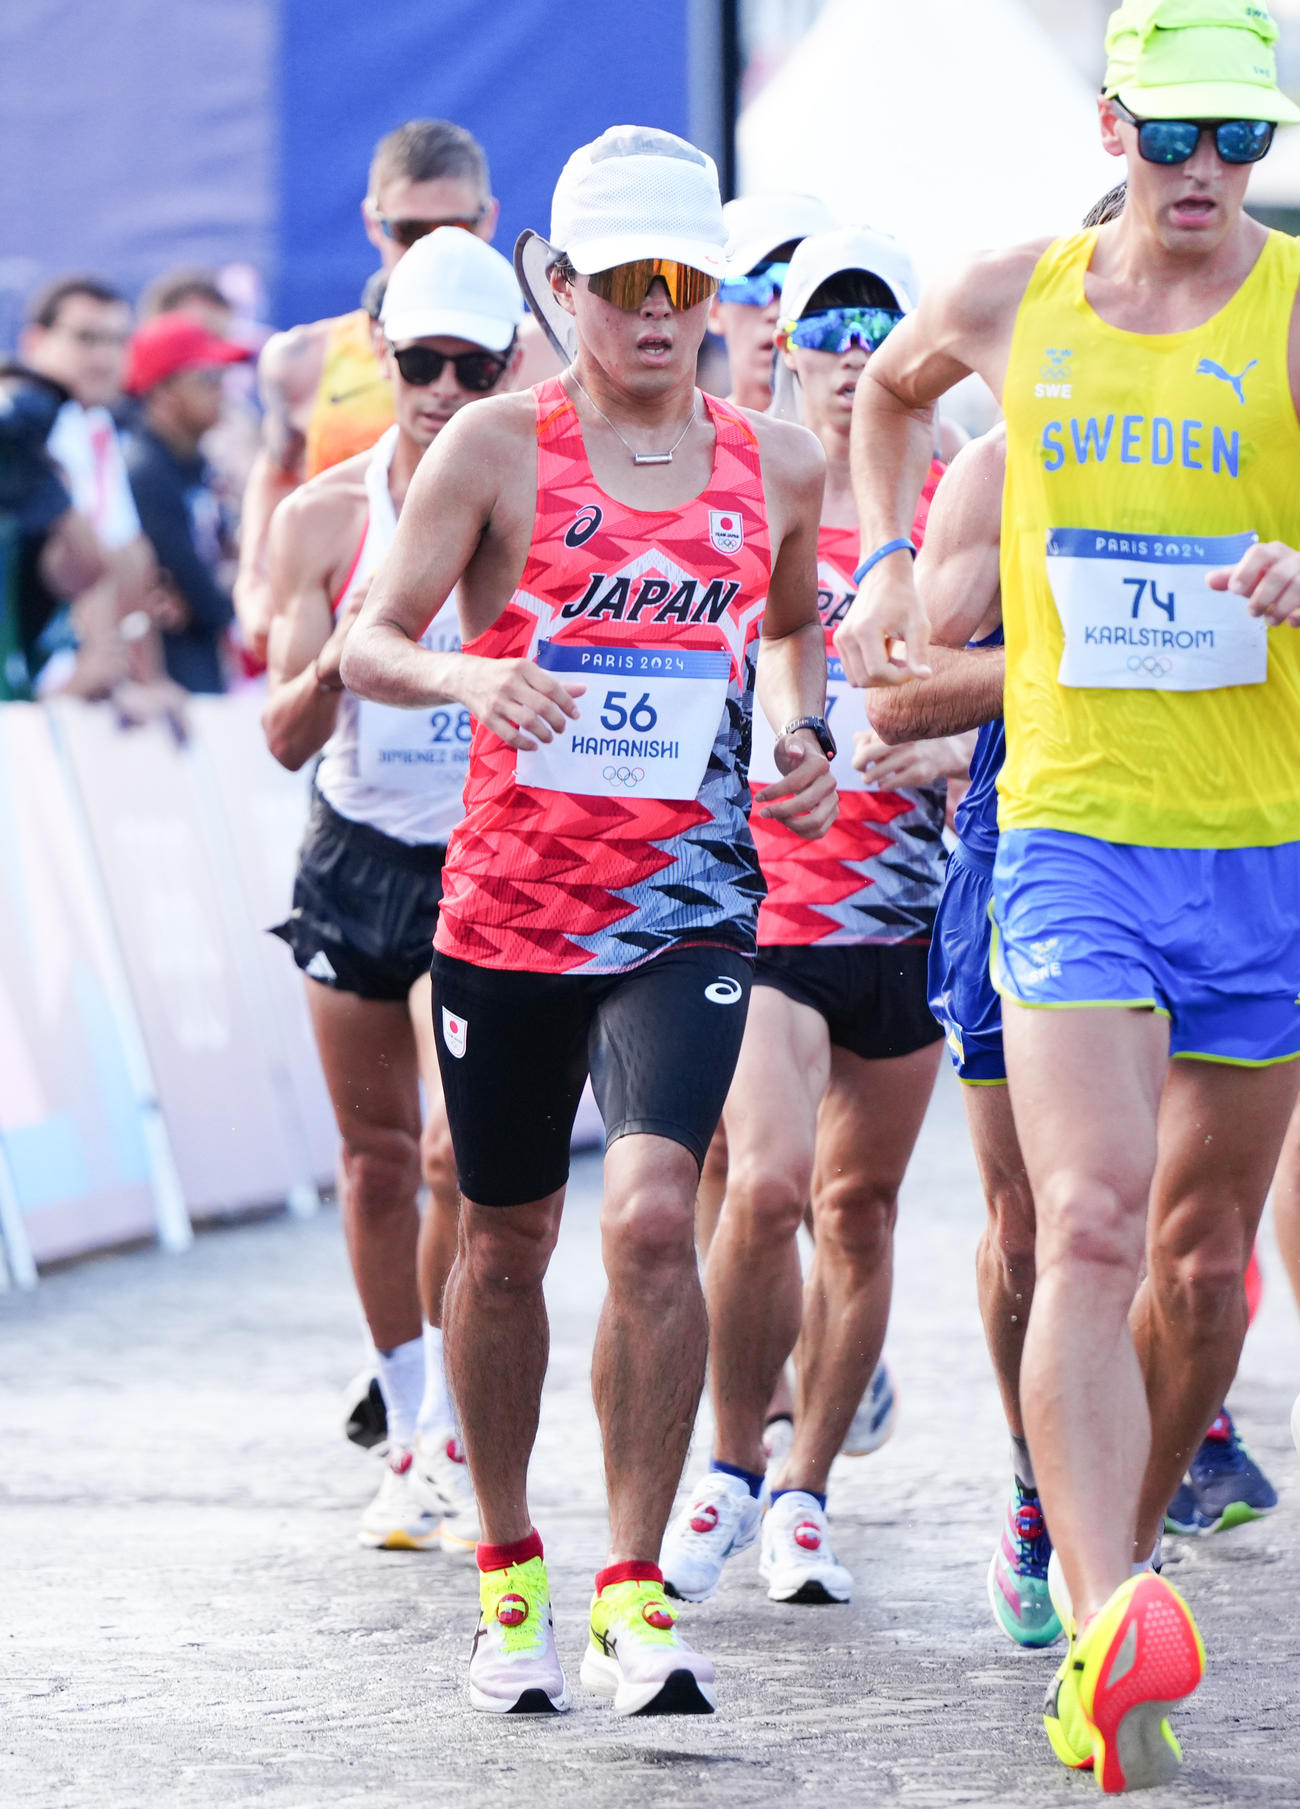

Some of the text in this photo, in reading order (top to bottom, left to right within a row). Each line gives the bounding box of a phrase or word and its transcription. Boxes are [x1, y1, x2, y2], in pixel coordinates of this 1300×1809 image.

[1034, 383, 1073, 399] SWE
[1042, 413, 1240, 478] SWEDEN
[1095, 537, 1205, 557] PARIS 2024
[561, 574, 740, 624] JAPAN
[1122, 577, 1175, 622] 74
[1083, 626, 1214, 649] KARLSTROM
[581, 653, 684, 671] PARIS 2024
[430, 709, 472, 743] 28
[600, 690, 658, 733] 56
[572, 735, 679, 760] HAMANISHI
